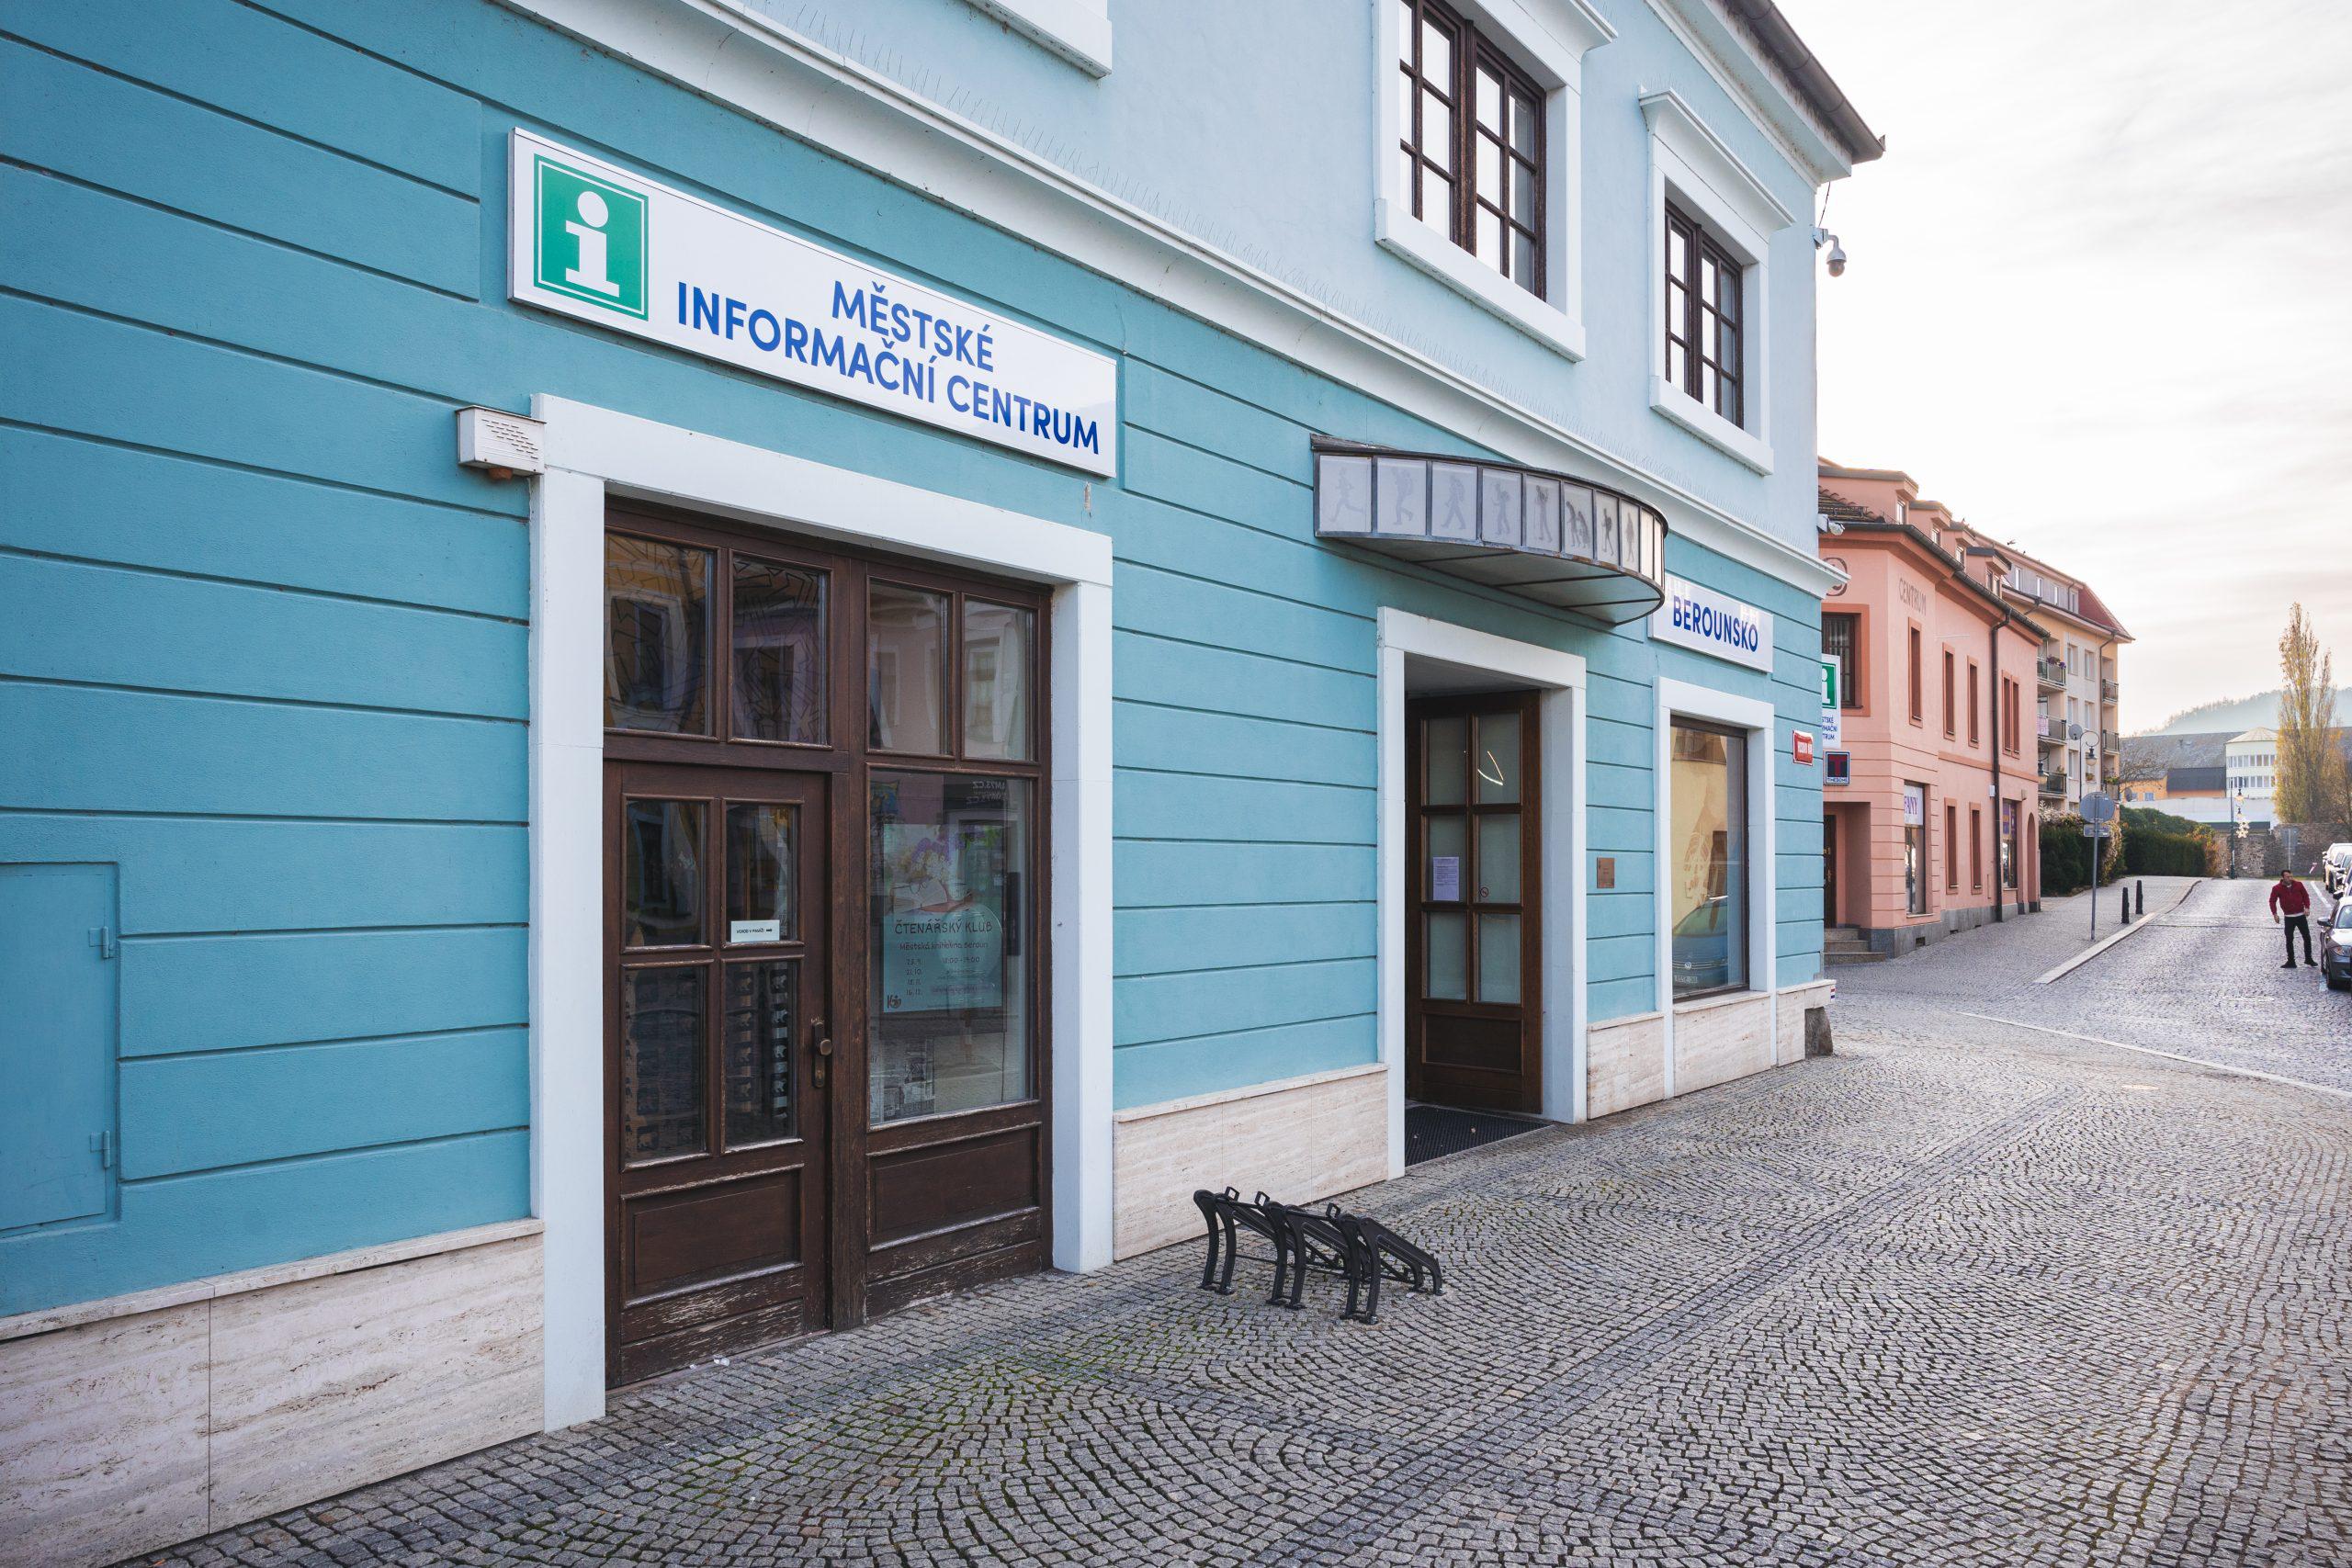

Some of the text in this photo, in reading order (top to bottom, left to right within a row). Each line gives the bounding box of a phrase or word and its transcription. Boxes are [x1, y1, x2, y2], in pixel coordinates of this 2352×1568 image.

[831, 281, 994, 372] MĚSTSKÉ
[678, 281, 1100, 455] INFORMAČNÍ CENTRUM
[1673, 595, 1758, 652] BEROUNSKO
[1898, 578, 1927, 616] CENTRUM
[895, 919, 993, 934] ČTENÁŘSKÝ KLUB
